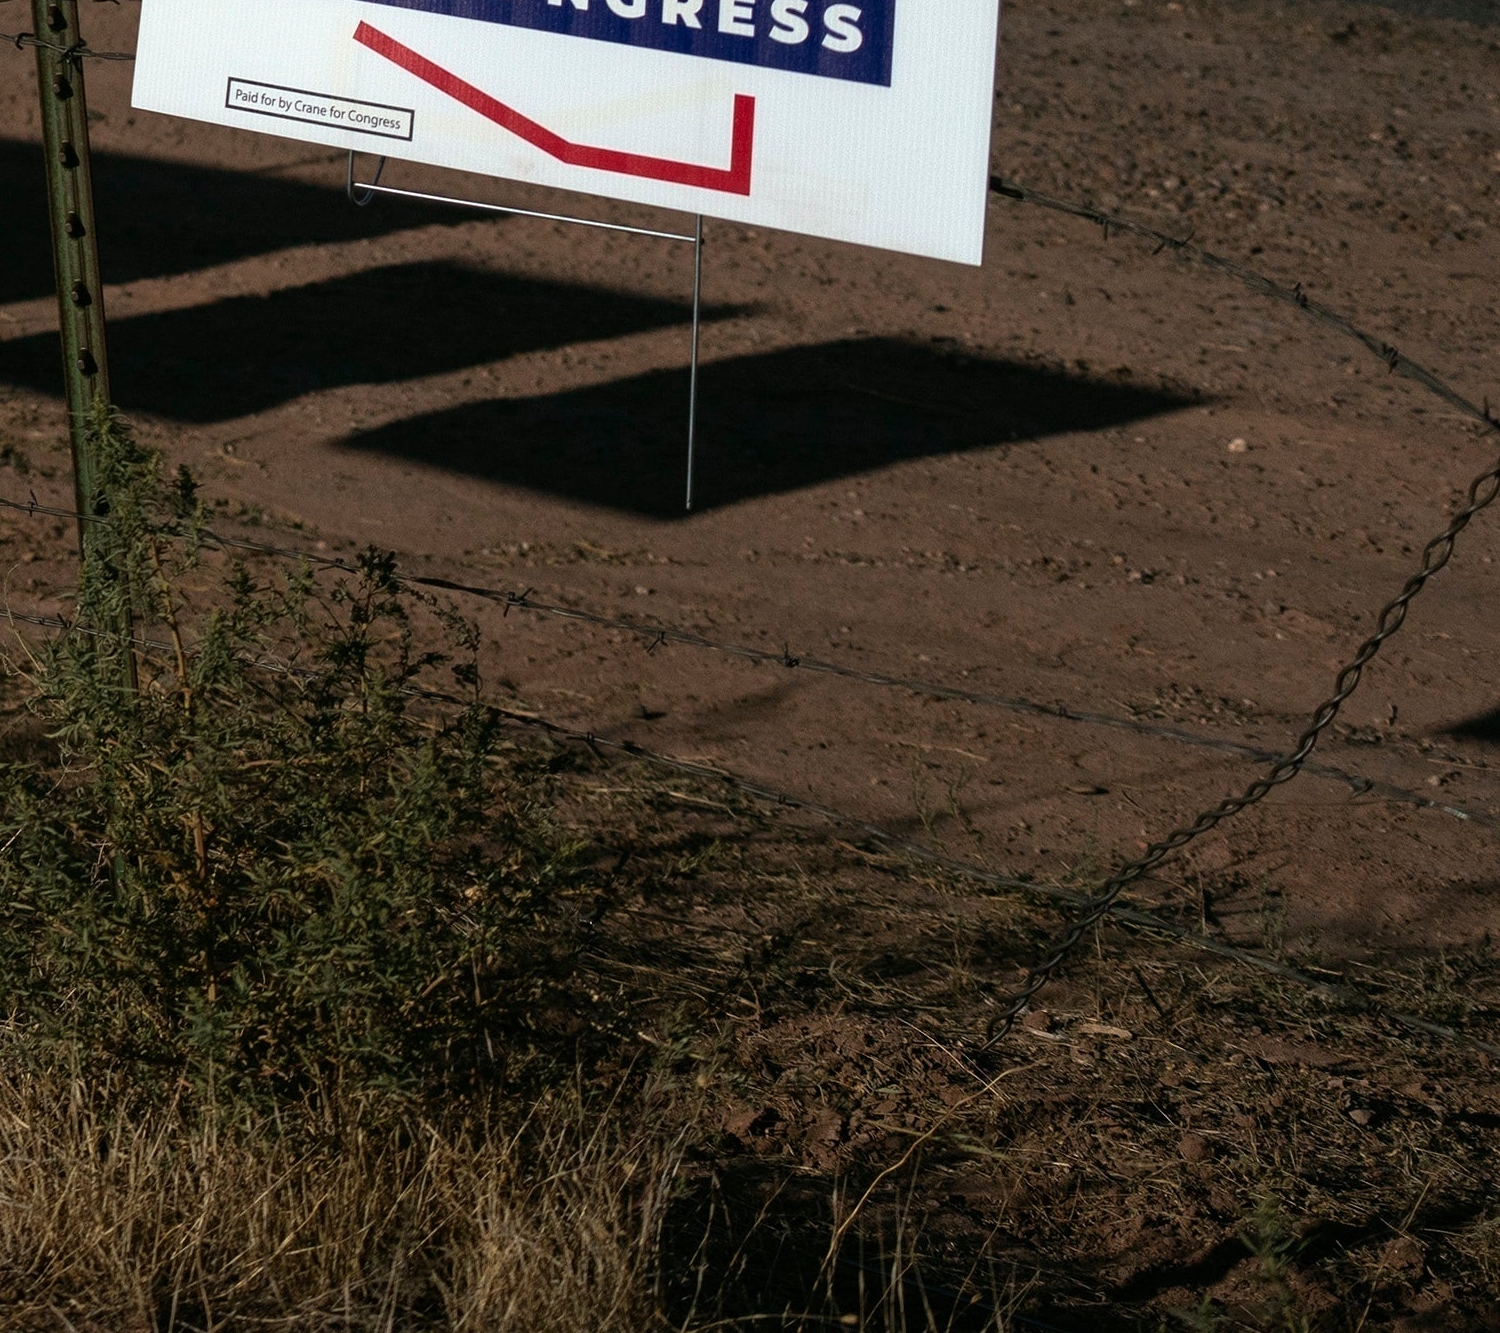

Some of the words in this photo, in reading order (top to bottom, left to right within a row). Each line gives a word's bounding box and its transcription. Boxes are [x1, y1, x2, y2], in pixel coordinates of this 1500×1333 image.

[235, 88, 258, 103] Paid
[261, 93, 276, 107] for
[279, 96, 292, 112] by
[294, 100, 327, 116] Crane
[330, 106, 346, 120] for
[348, 109, 401, 130] Congress
